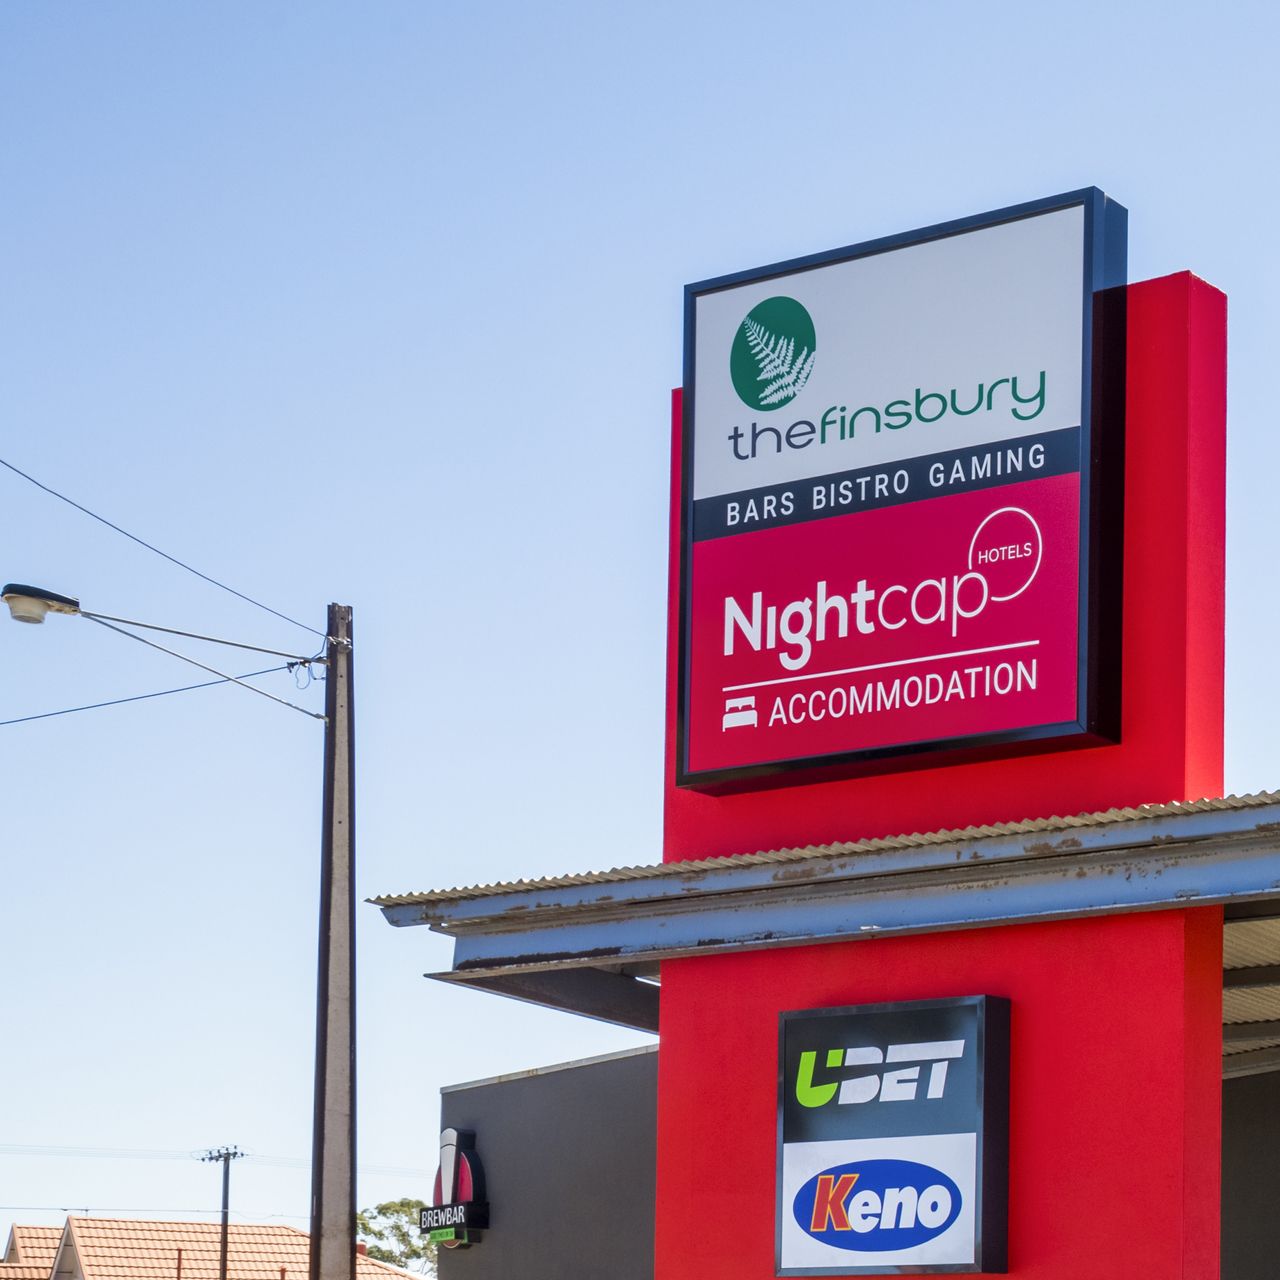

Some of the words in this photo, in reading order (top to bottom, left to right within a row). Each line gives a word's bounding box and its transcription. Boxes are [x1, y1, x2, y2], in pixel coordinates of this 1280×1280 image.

[728, 371, 1046, 460] thefinsbury
[727, 491, 795, 526] BARS
[813, 470, 909, 510] BISTRO
[929, 443, 1046, 488] GAMING
[978, 542, 1032, 564] HOTELS
[724, 571, 989, 671] Nightcap
[768, 659, 1037, 727] ACCOMMODATION
[796, 1039, 965, 1108] UBET
[421, 1205, 465, 1229] BREWBAR
[810, 1174, 952, 1233] Keno
